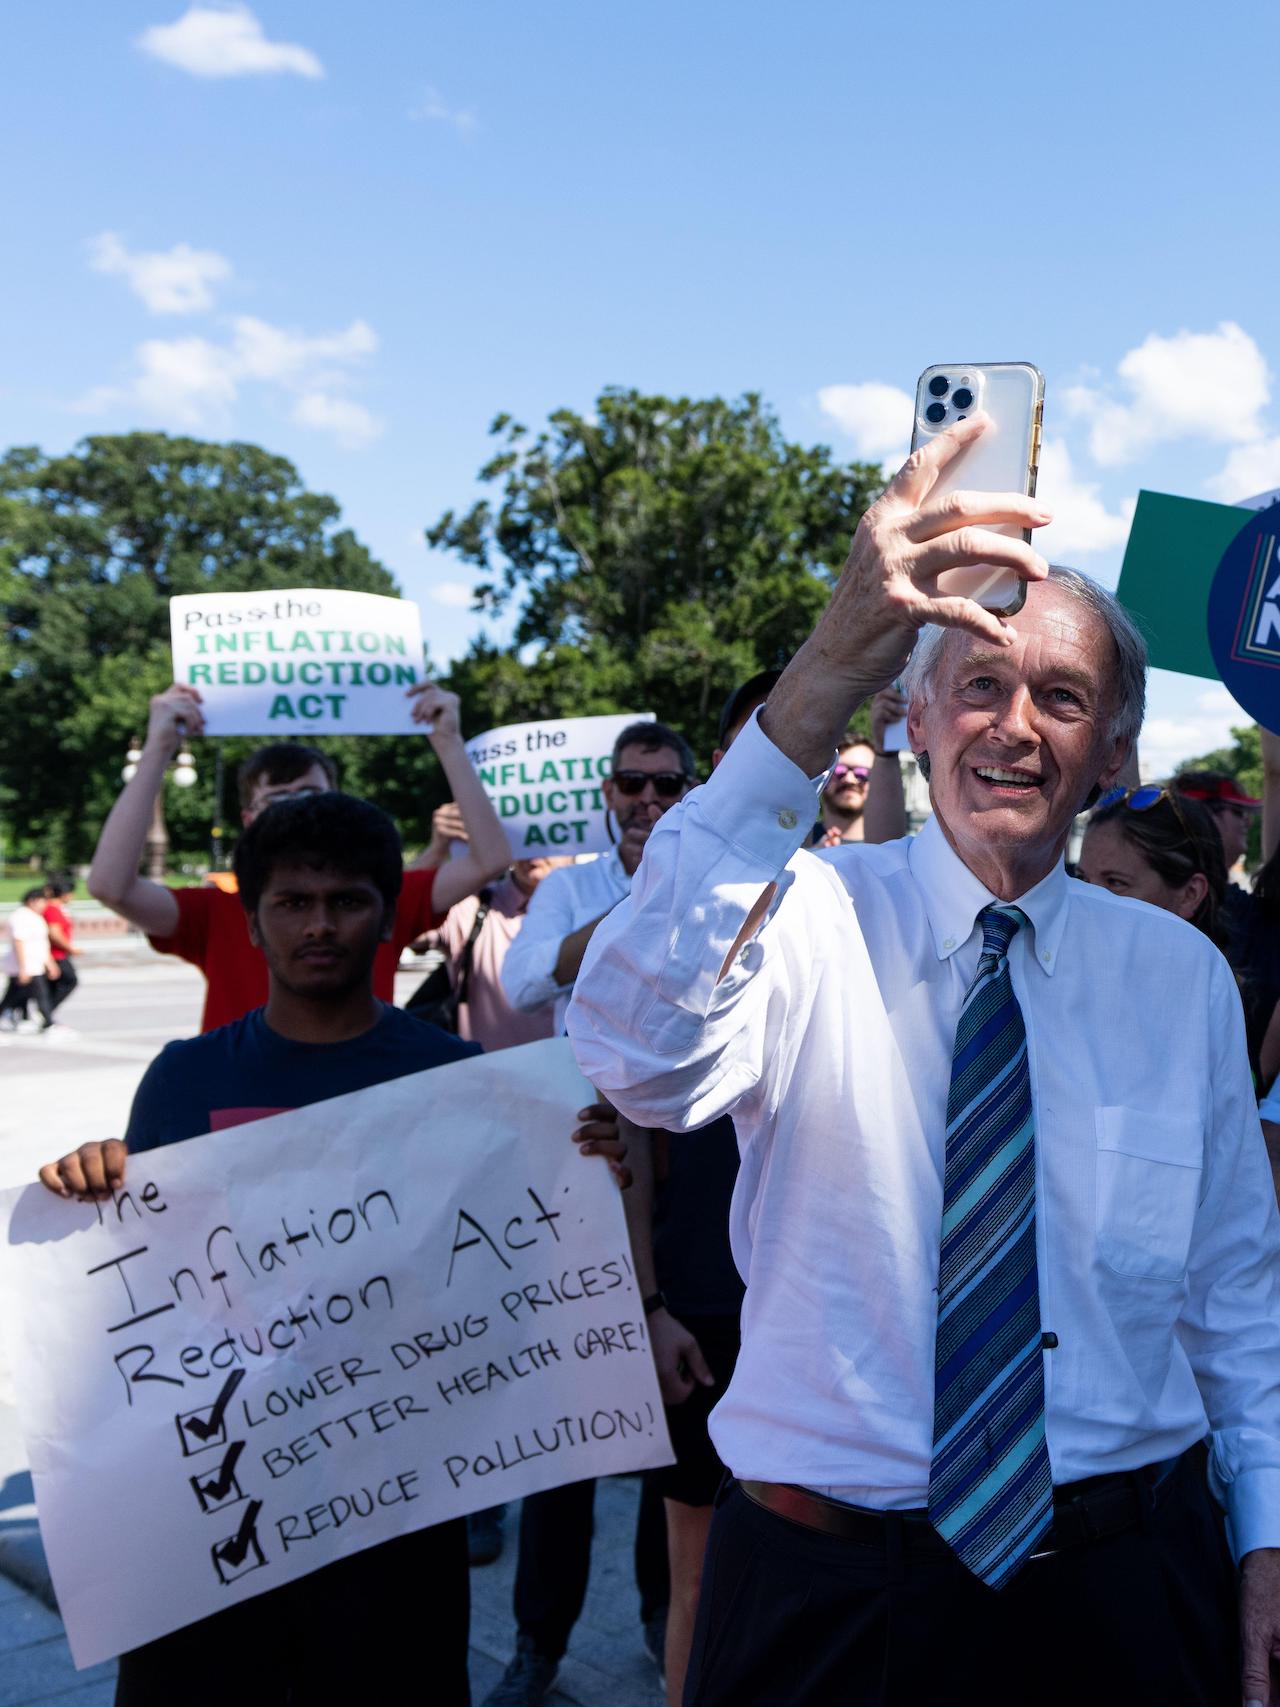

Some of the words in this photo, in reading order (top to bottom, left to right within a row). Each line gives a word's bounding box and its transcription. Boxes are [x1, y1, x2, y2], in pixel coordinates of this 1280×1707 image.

[184, 609, 266, 631] Pass
[274, 599, 322, 618] the
[194, 630, 407, 656] INFLATION
[188, 661, 417, 686] REDUCTION
[268, 694, 347, 720] ACT
[526, 729, 567, 751] the
[524, 821, 589, 847] ACT
[87, 1189, 400, 1332] Inflation
[113, 1275, 394, 1407] Reduction
[243, 1357, 382, 1428] LOWER
[390, 1314, 489, 1371] DRUG
[500, 1253, 633, 1323] PRICES!
[261, 1395, 430, 1479] BETTER
[436, 1339, 562, 1405] HEALTH
[573, 1321, 647, 1360] CARE!
[275, 1469, 421, 1553] REDUCE
